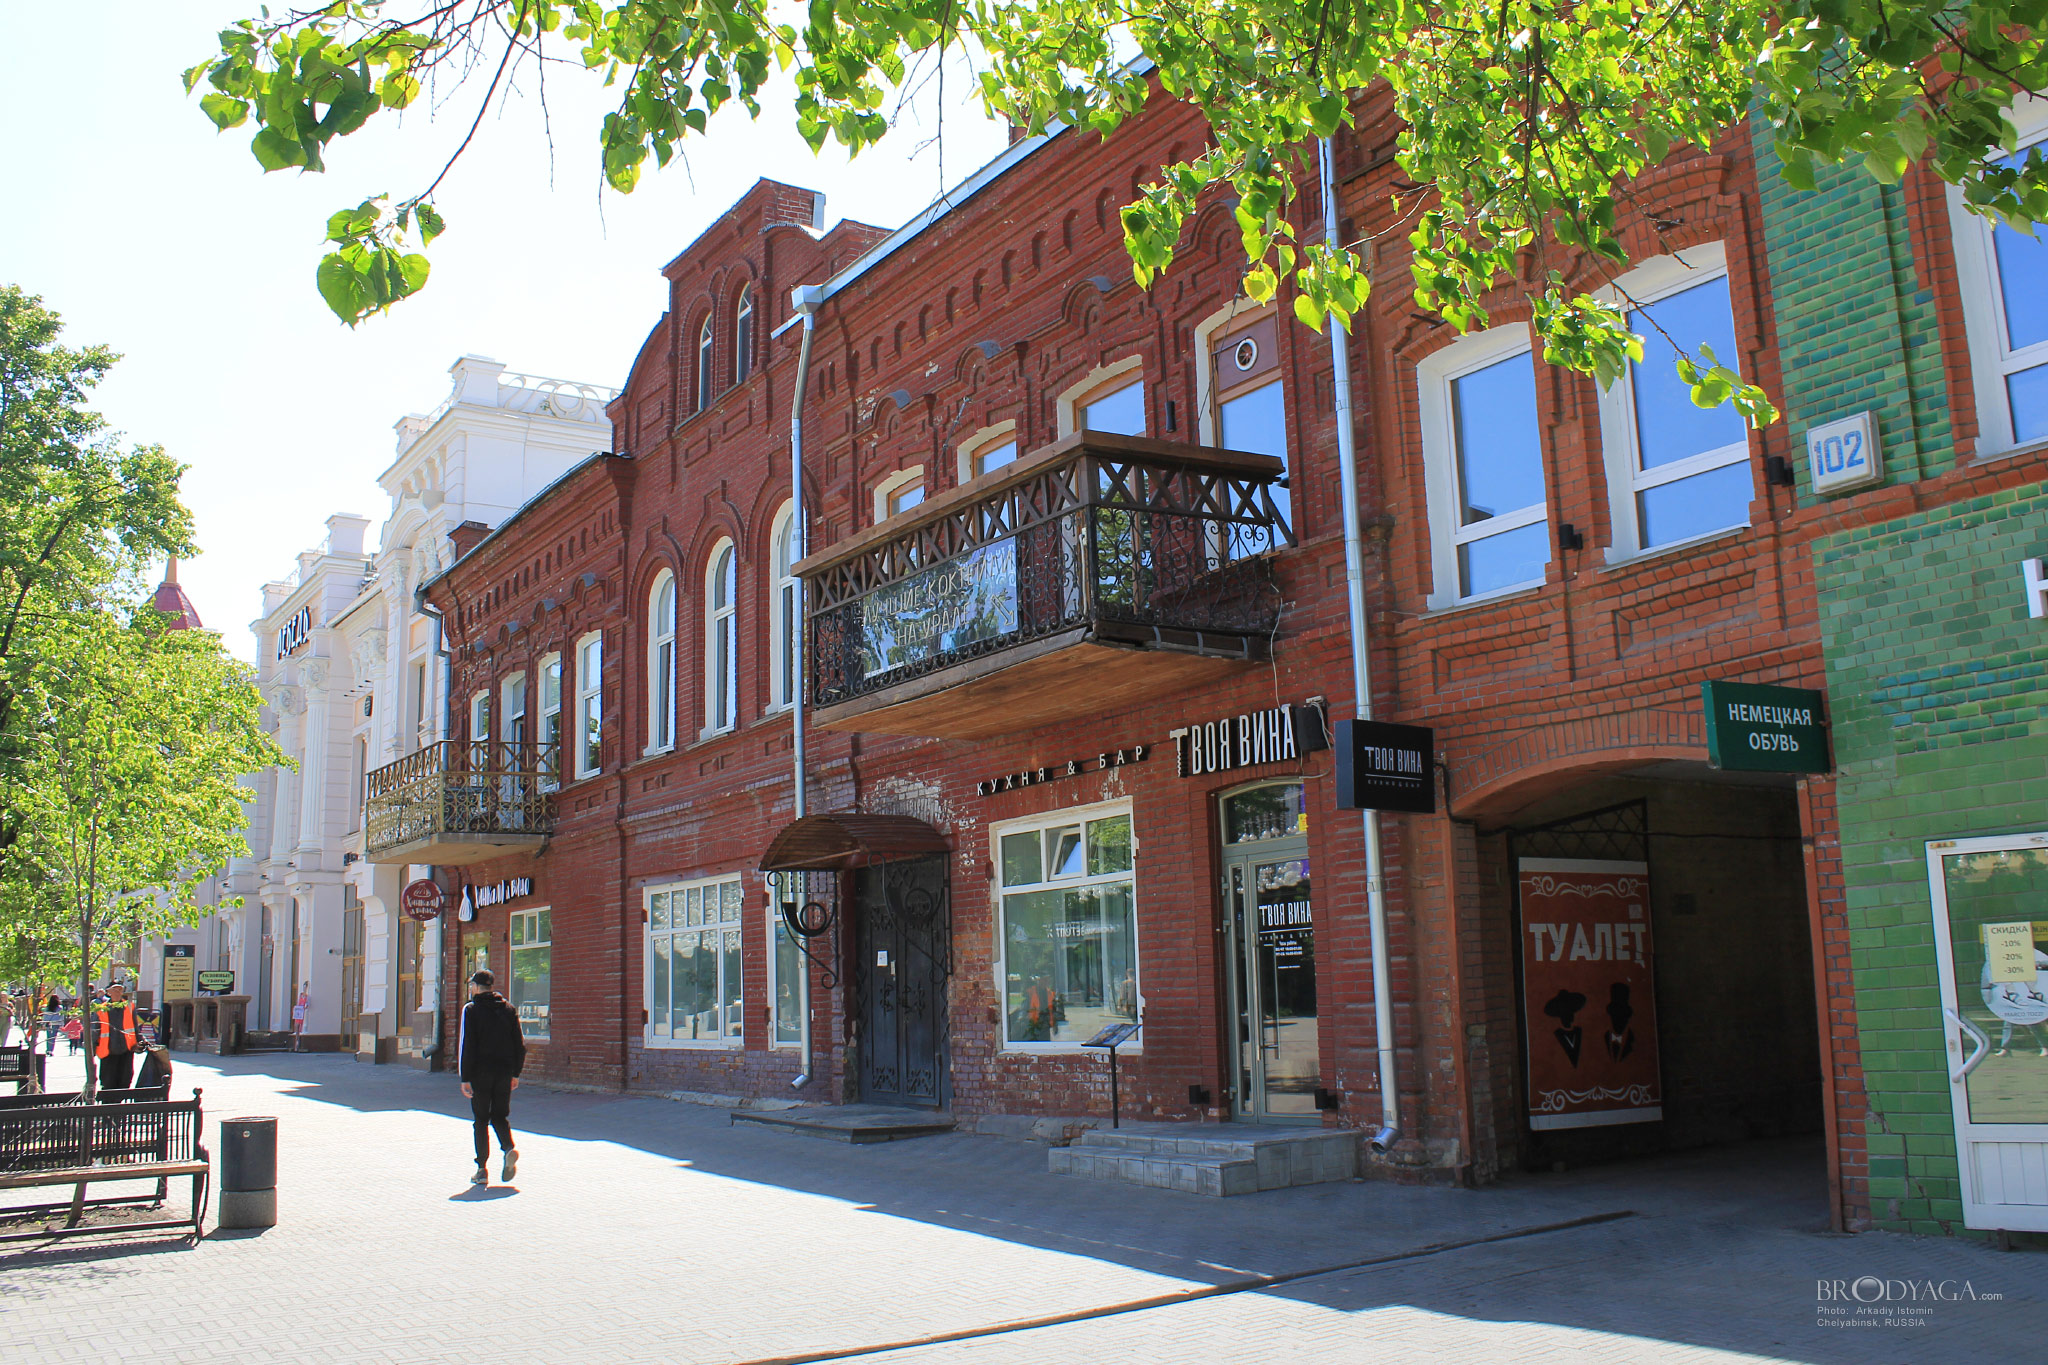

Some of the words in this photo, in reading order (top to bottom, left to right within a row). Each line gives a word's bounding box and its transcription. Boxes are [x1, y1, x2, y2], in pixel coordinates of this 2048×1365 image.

[1813, 430, 1865, 476] 102
[864, 585, 921, 625] ЛУЧШИЕ
[928, 549, 1014, 600] КОКТЕЙЛИ
[897, 623, 917, 647] НА
[923, 601, 970, 639] УРАЛЕ
[1727, 703, 1812, 729] НЕМЕЦКАЯ
[1169, 718, 1231, 778] ТВОЯ
[1239, 704, 1296, 767] ВИНА
[1748, 732, 1799, 752] ОБУВЬ
[977, 767, 1045, 796] КУХНЯ
[1067, 760, 1076, 775] &
[1100, 745, 1144, 768] БАР
[1364, 746, 1394, 771] ТВОЯ
[1397, 749, 1422, 774] ВИНА
[1258, 903, 1285, 927] ТВОЯ
[1288, 901, 1313, 925] ВИНА
[1991, 925, 2029, 934] СКИДКА
[1529, 922, 1646, 964] ТУАЛЕТ
[2004, 966, 2025, 974] -30%
